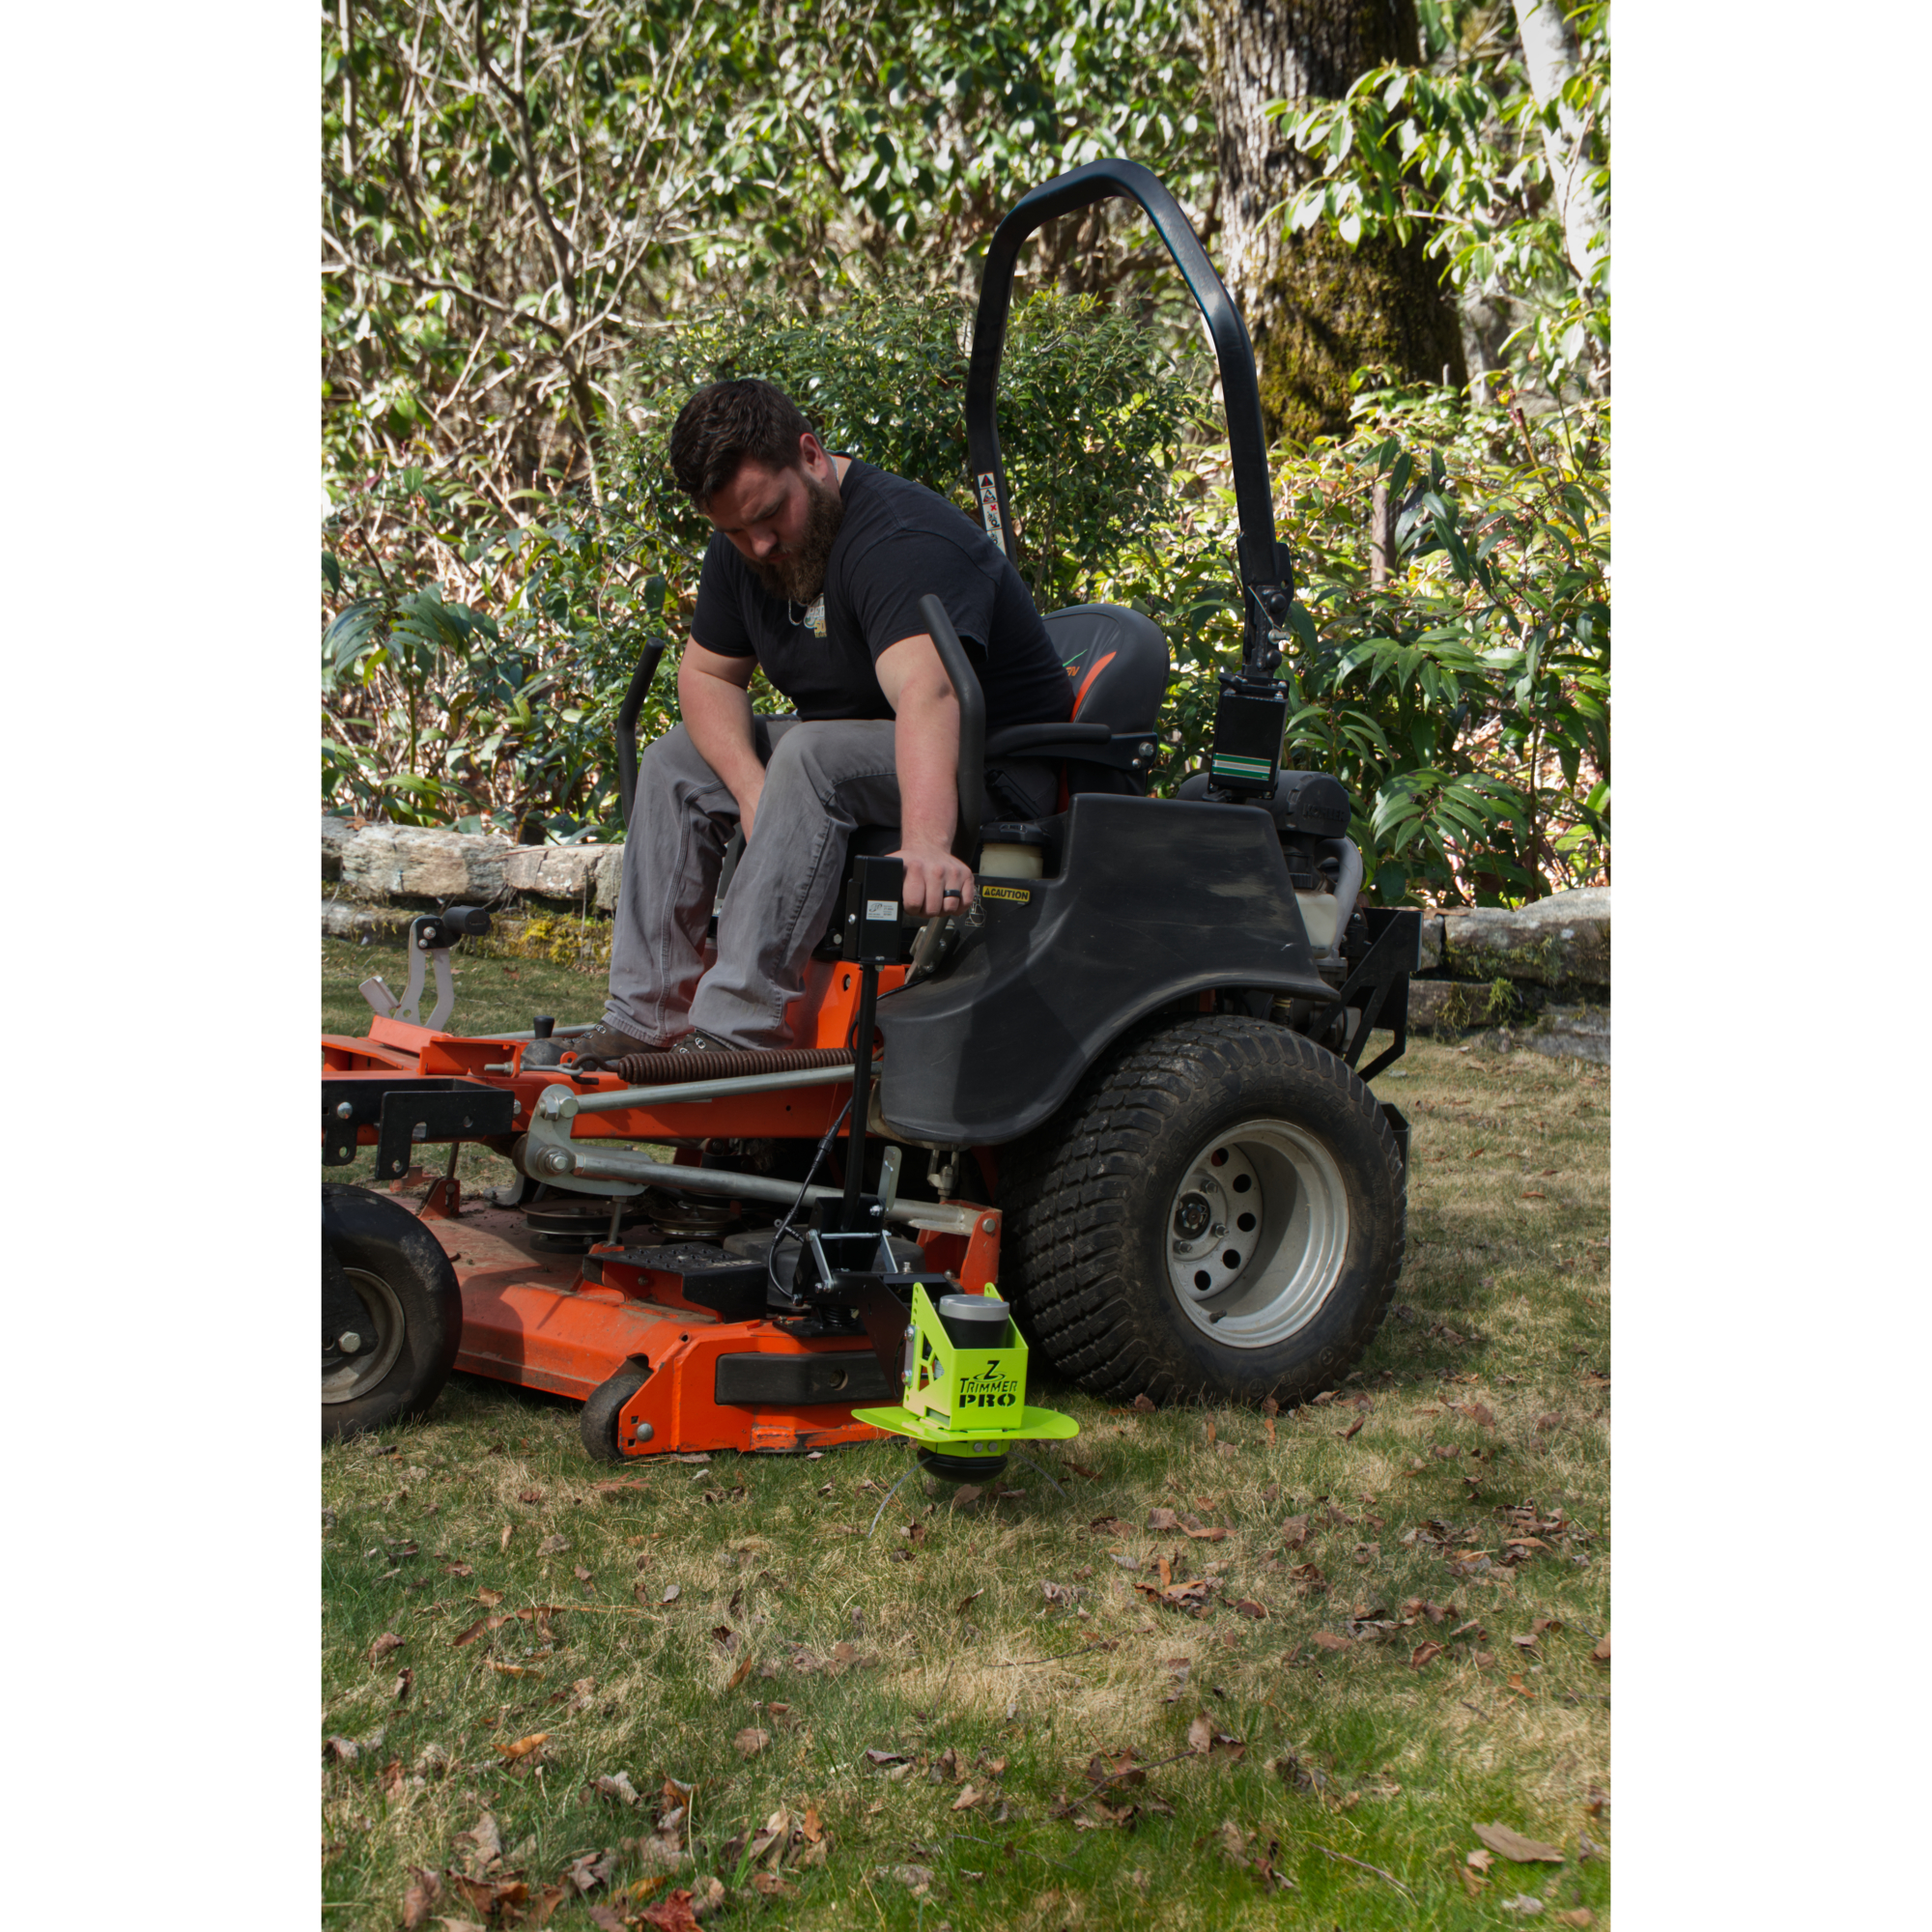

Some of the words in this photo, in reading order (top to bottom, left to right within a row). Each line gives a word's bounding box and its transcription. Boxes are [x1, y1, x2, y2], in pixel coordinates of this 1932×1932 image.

[1302, 803, 1346, 822] KOHLER
[991, 888, 1029, 900] CAUTION
[983, 1360, 1000, 1379] Z
[959, 1378, 1018, 1394] TRIMMER
[959, 1393, 1016, 1408] PRO
